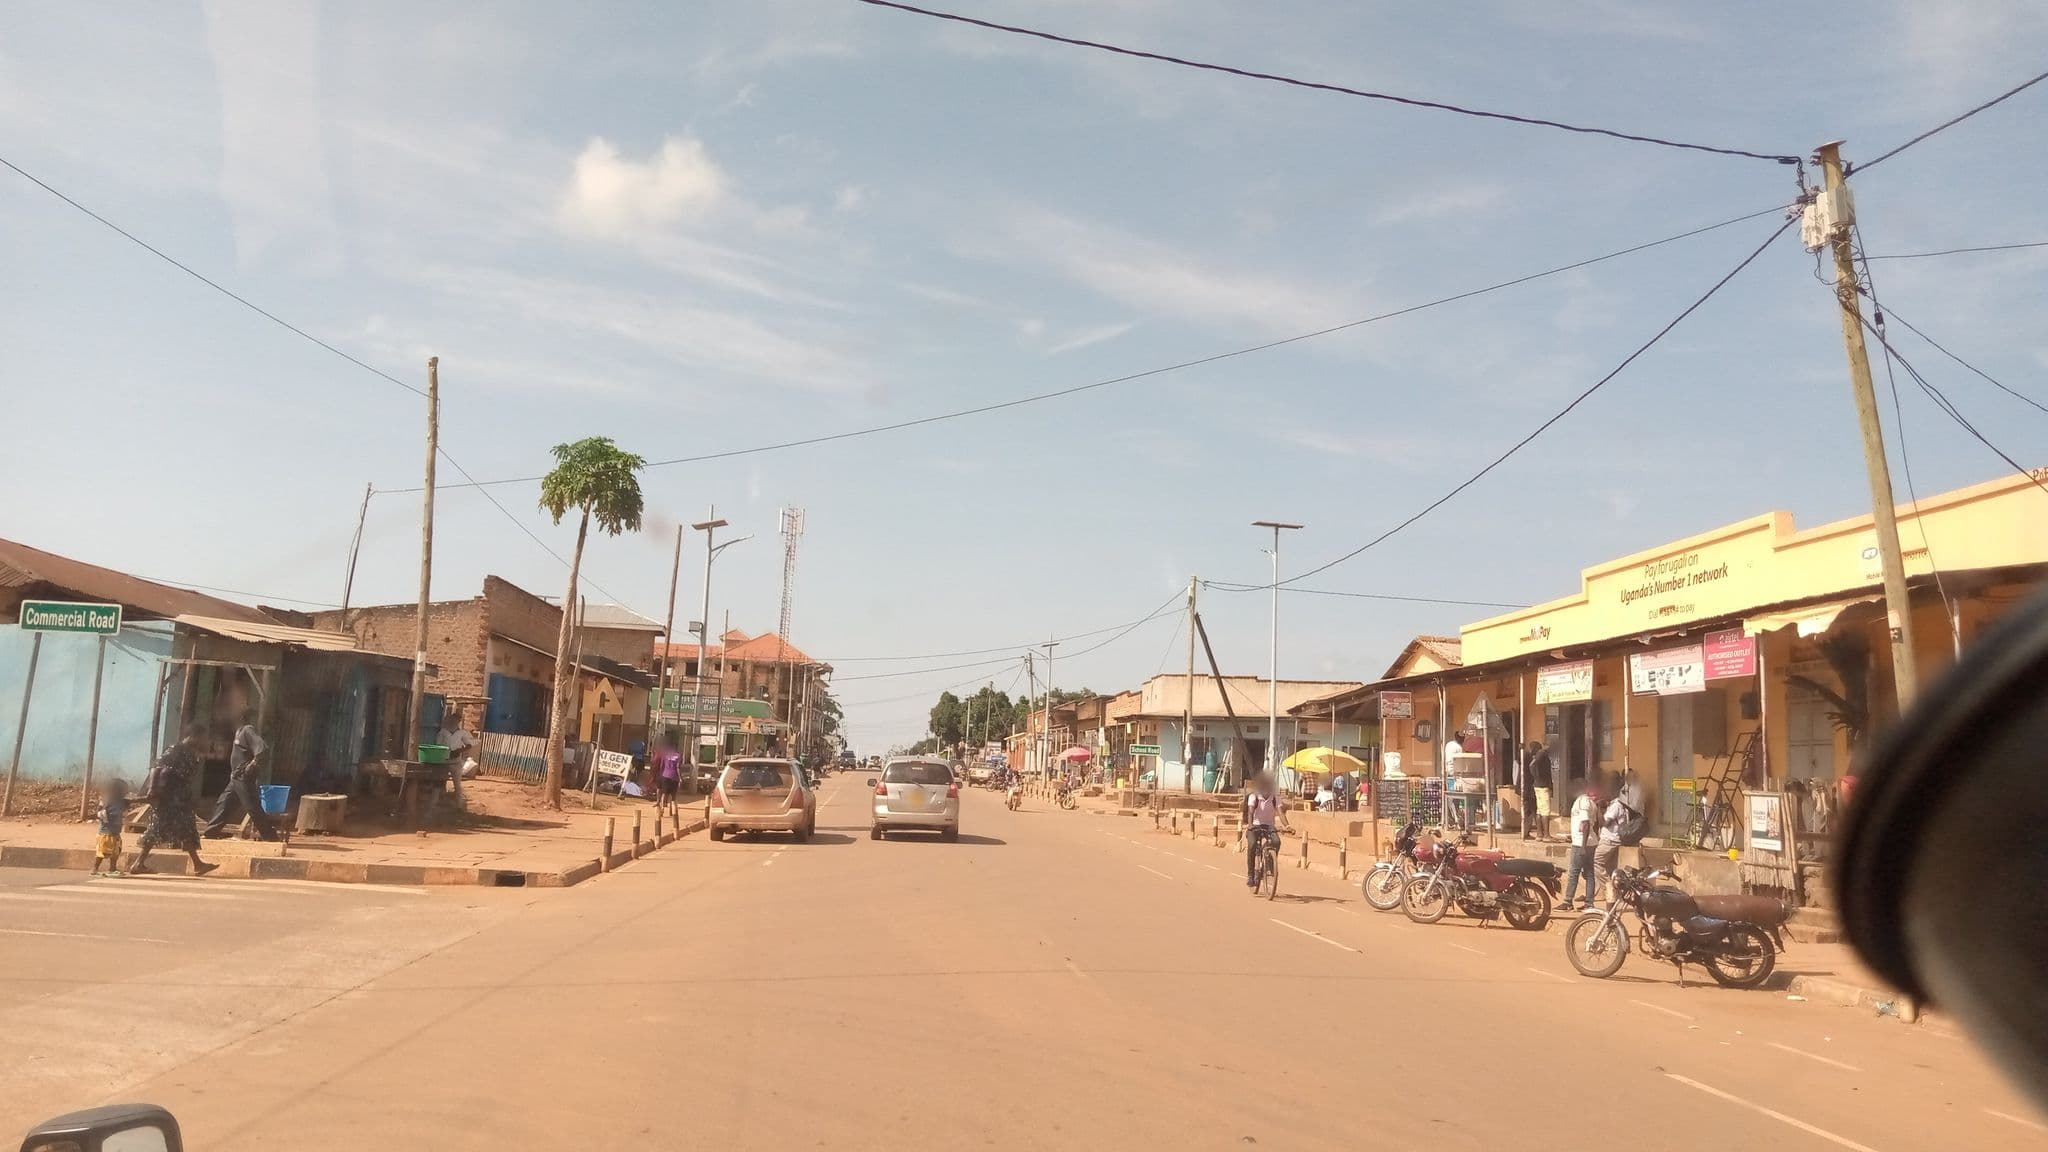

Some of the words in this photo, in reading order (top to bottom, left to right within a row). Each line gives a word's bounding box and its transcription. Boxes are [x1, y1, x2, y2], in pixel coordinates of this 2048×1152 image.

[1644, 564, 1658, 579] Pay
[1658, 559, 1669, 575] for
[1669, 553, 1687, 574] ugali
[1687, 553, 1699, 566] on
[1620, 582, 1654, 606] Uganda's
[1654, 575, 1686, 595] Number
[1687, 573, 1691, 587] 1
[1692, 562, 1729, 585] network
[26, 607, 86, 628] Commercial
[88, 610, 116, 629] Road
